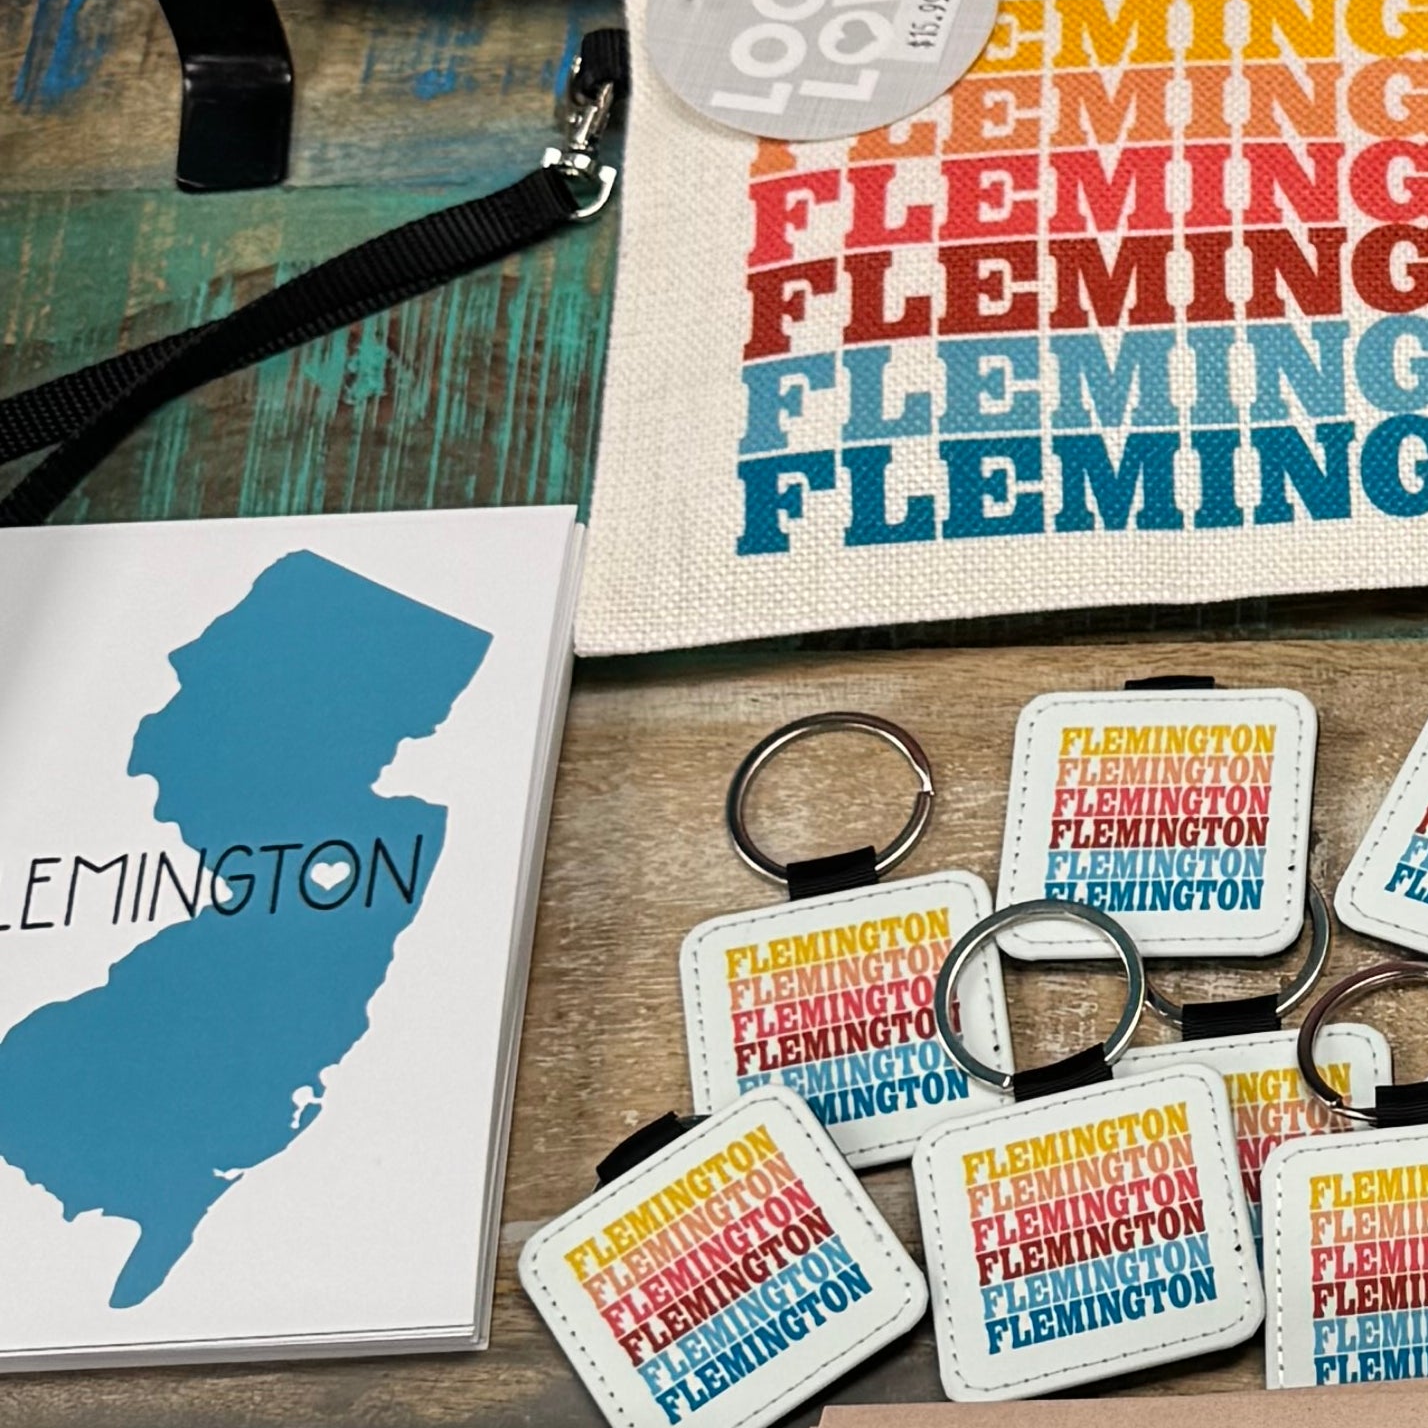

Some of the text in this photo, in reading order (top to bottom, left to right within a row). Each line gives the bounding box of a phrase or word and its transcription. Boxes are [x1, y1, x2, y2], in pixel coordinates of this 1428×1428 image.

[1056, 754, 1275, 788] FLEMINGTON
[1059, 723, 1277, 758] FLEMINGTON
[1048, 815, 1271, 851] FLEMINGTON
[1052, 784, 1273, 819] FLEMINGTON
[1046, 846, 1268, 881] FLEMINGTON
[725, 906, 951, 981] FLEMINGTON
[731, 974, 958, 1045] FLEMINGTO
[962, 1101, 1190, 1187] FLEMINGTON
[966, 1133, 1195, 1219] FLEMINGTON
[563, 1123, 782, 1283] FLEMINGTON
[581, 1151, 799, 1310] FLEMINGTON
[970, 1165, 1201, 1253] FLEMINGTON
[975, 1198, 1207, 1287] FLEMINGTON
[599, 1178, 818, 1338] FLEMINGTON
[617, 1206, 837, 1367] FLEMINGTON
[979, 1231, 1213, 1321] FLEMINGTON
[636, 1234, 855, 1396] FLEMINGTON
[654, 1262, 874, 1426] FLEMINGTON
[984, 1266, 1218, 1356] FLEMINGTON
